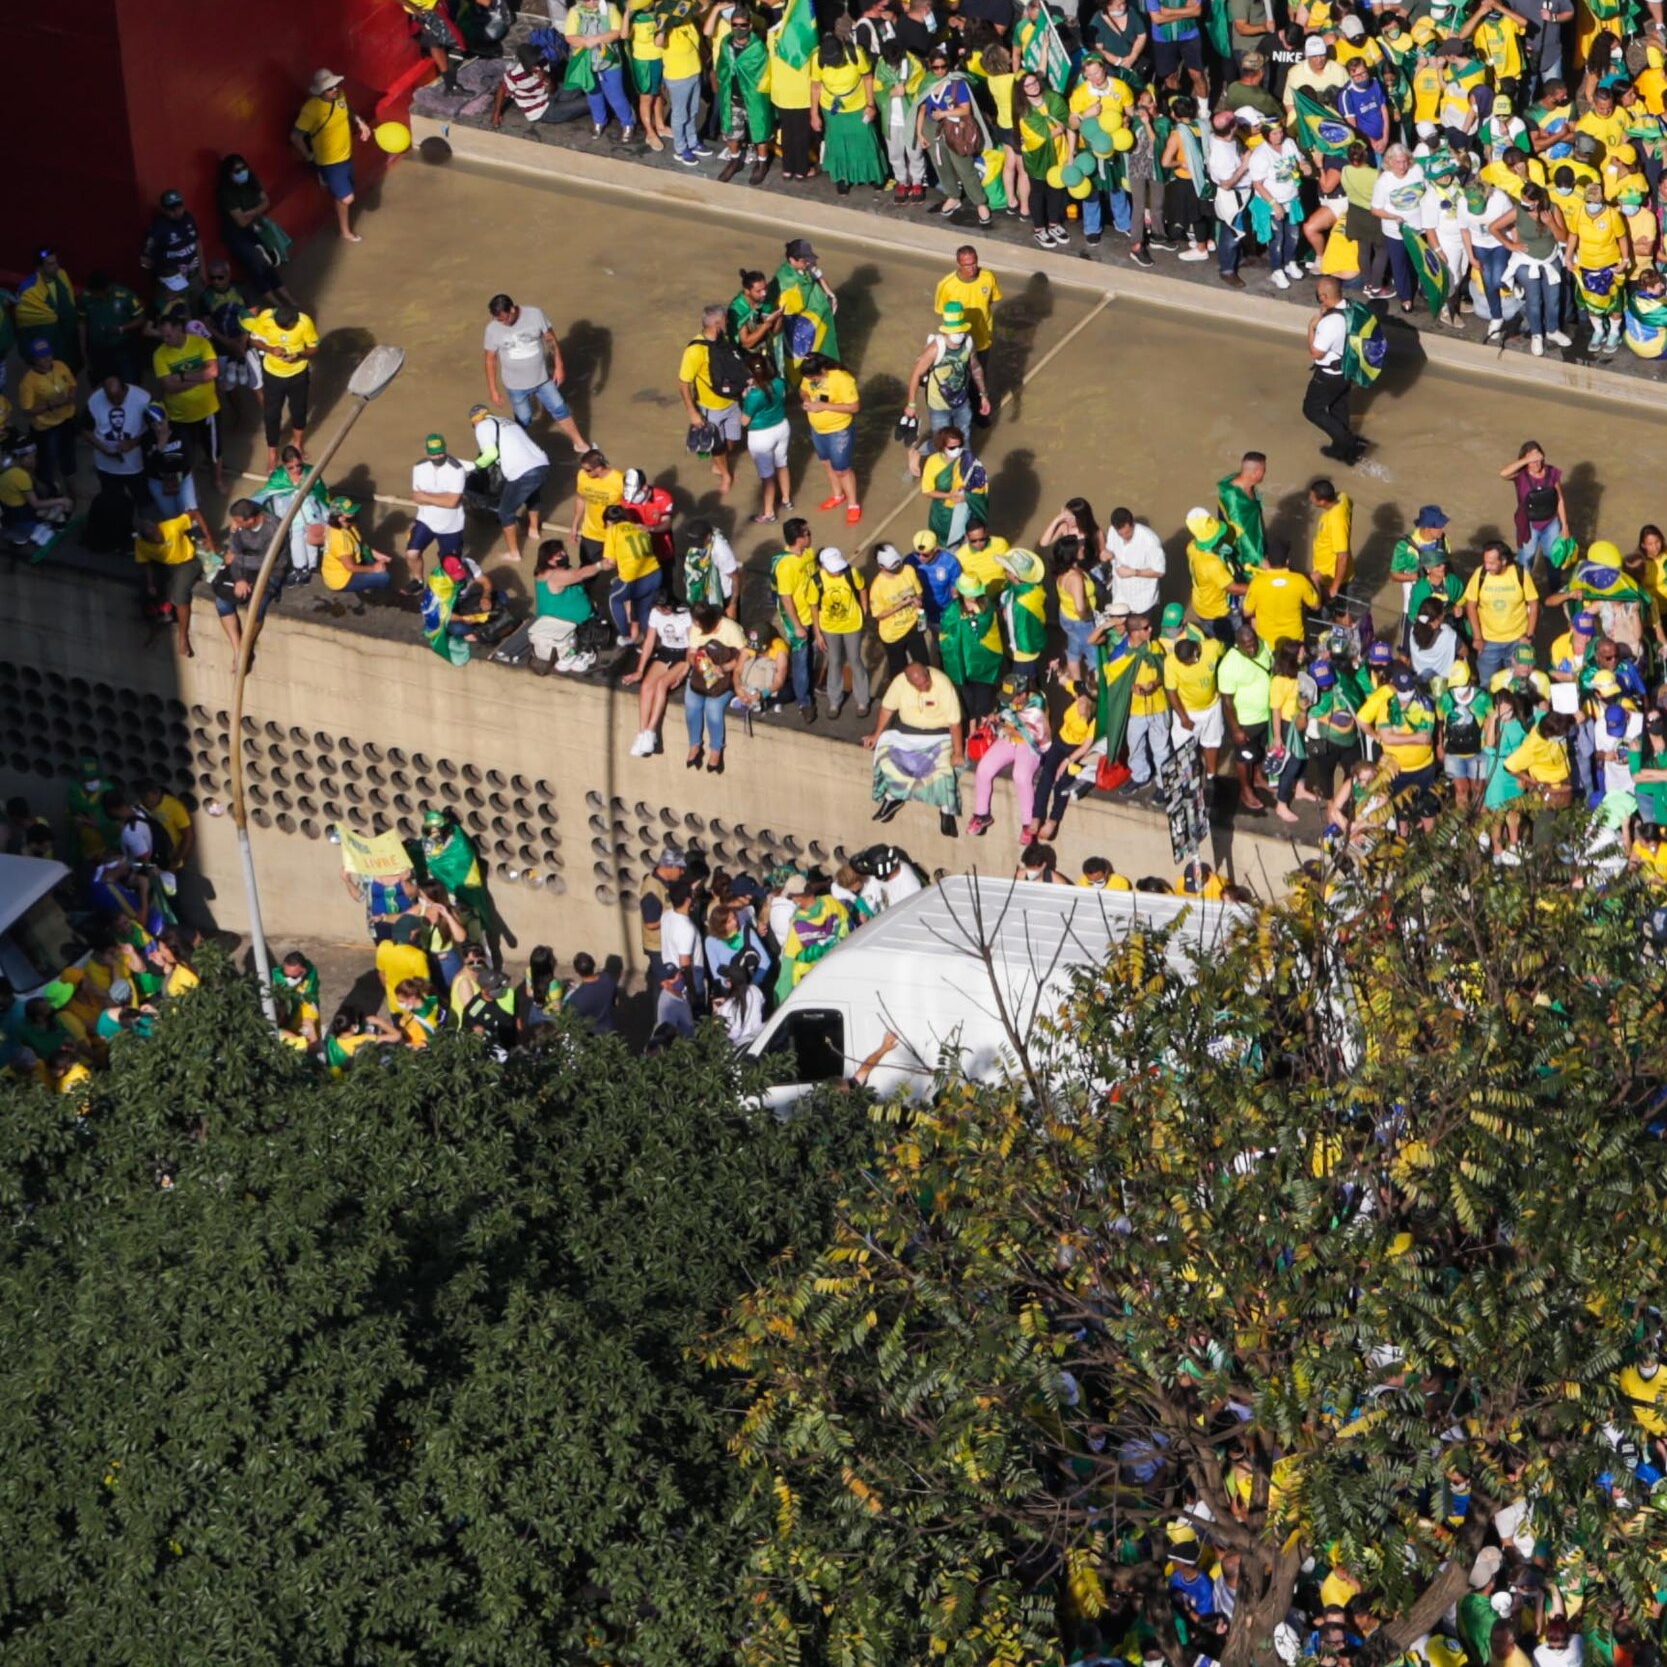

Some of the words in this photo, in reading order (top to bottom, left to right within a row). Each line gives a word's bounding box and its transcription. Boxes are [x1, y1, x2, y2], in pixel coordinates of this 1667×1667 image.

[1272, 50, 1303, 63] NIKE
[625, 532, 652, 560] 10
[364, 855, 397, 867] LIVRE
